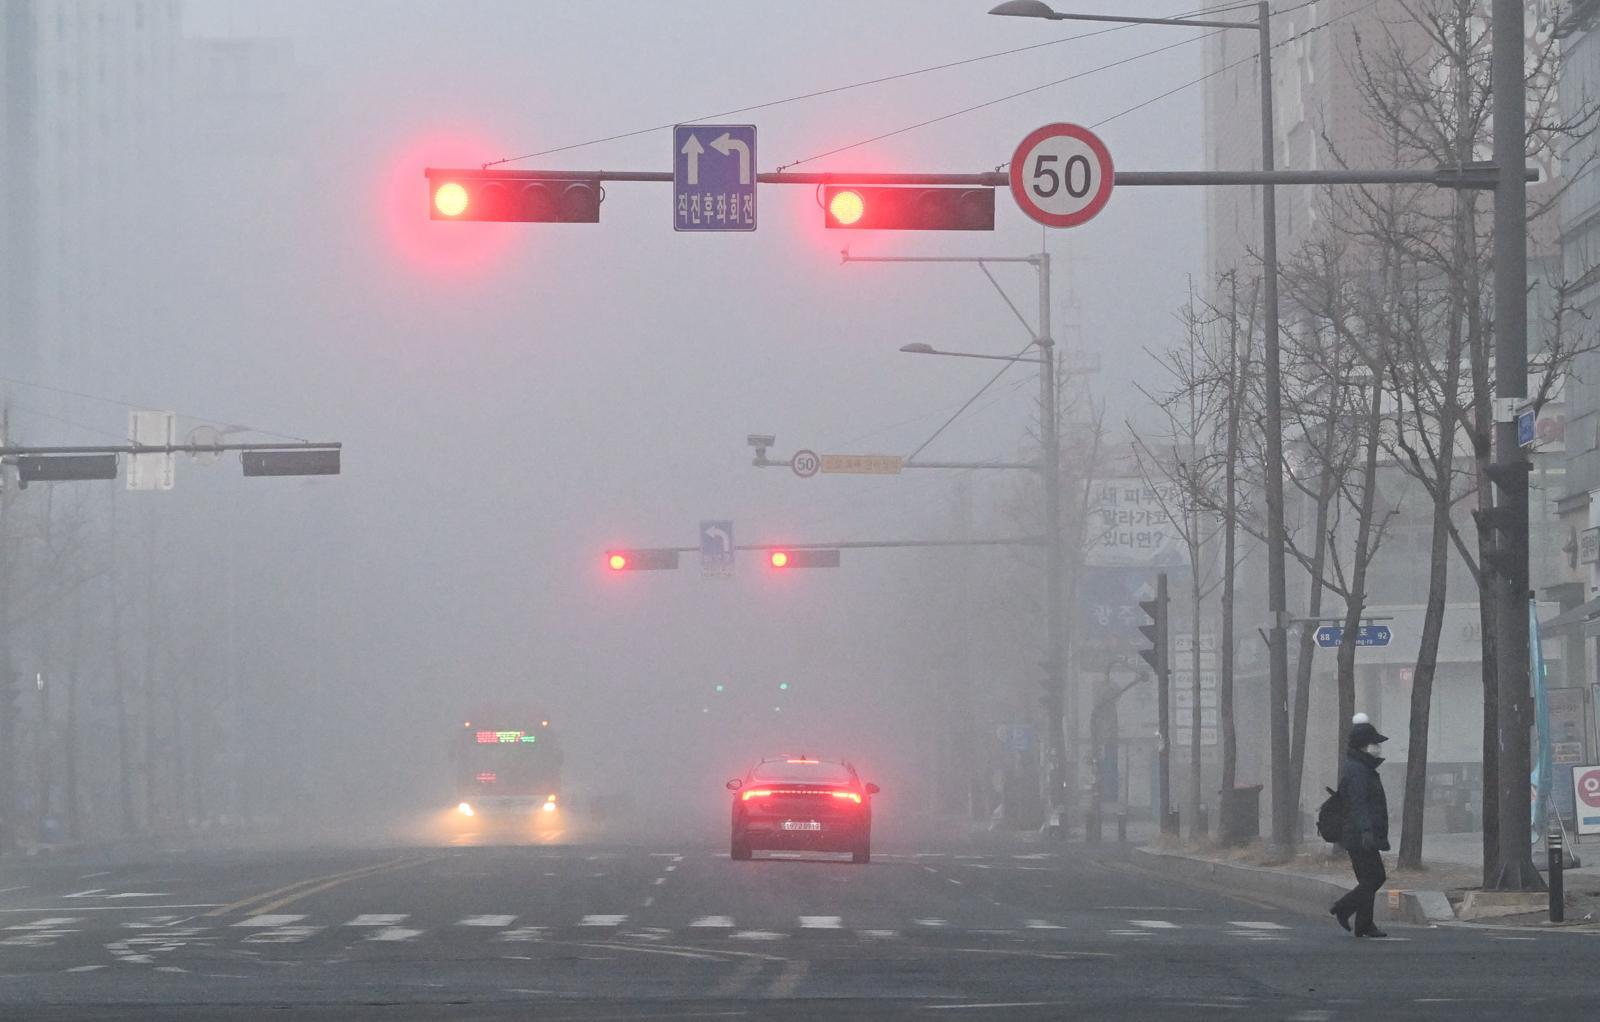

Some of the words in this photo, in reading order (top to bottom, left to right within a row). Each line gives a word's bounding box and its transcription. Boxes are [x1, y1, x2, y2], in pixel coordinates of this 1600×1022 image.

[1033, 154, 1091, 198] 50
[678, 192, 753, 224] 직진후좌회전
[798, 458, 814, 471] 50
[1320, 633, 1330, 641] 88
[1377, 631, 1387, 640] 92
